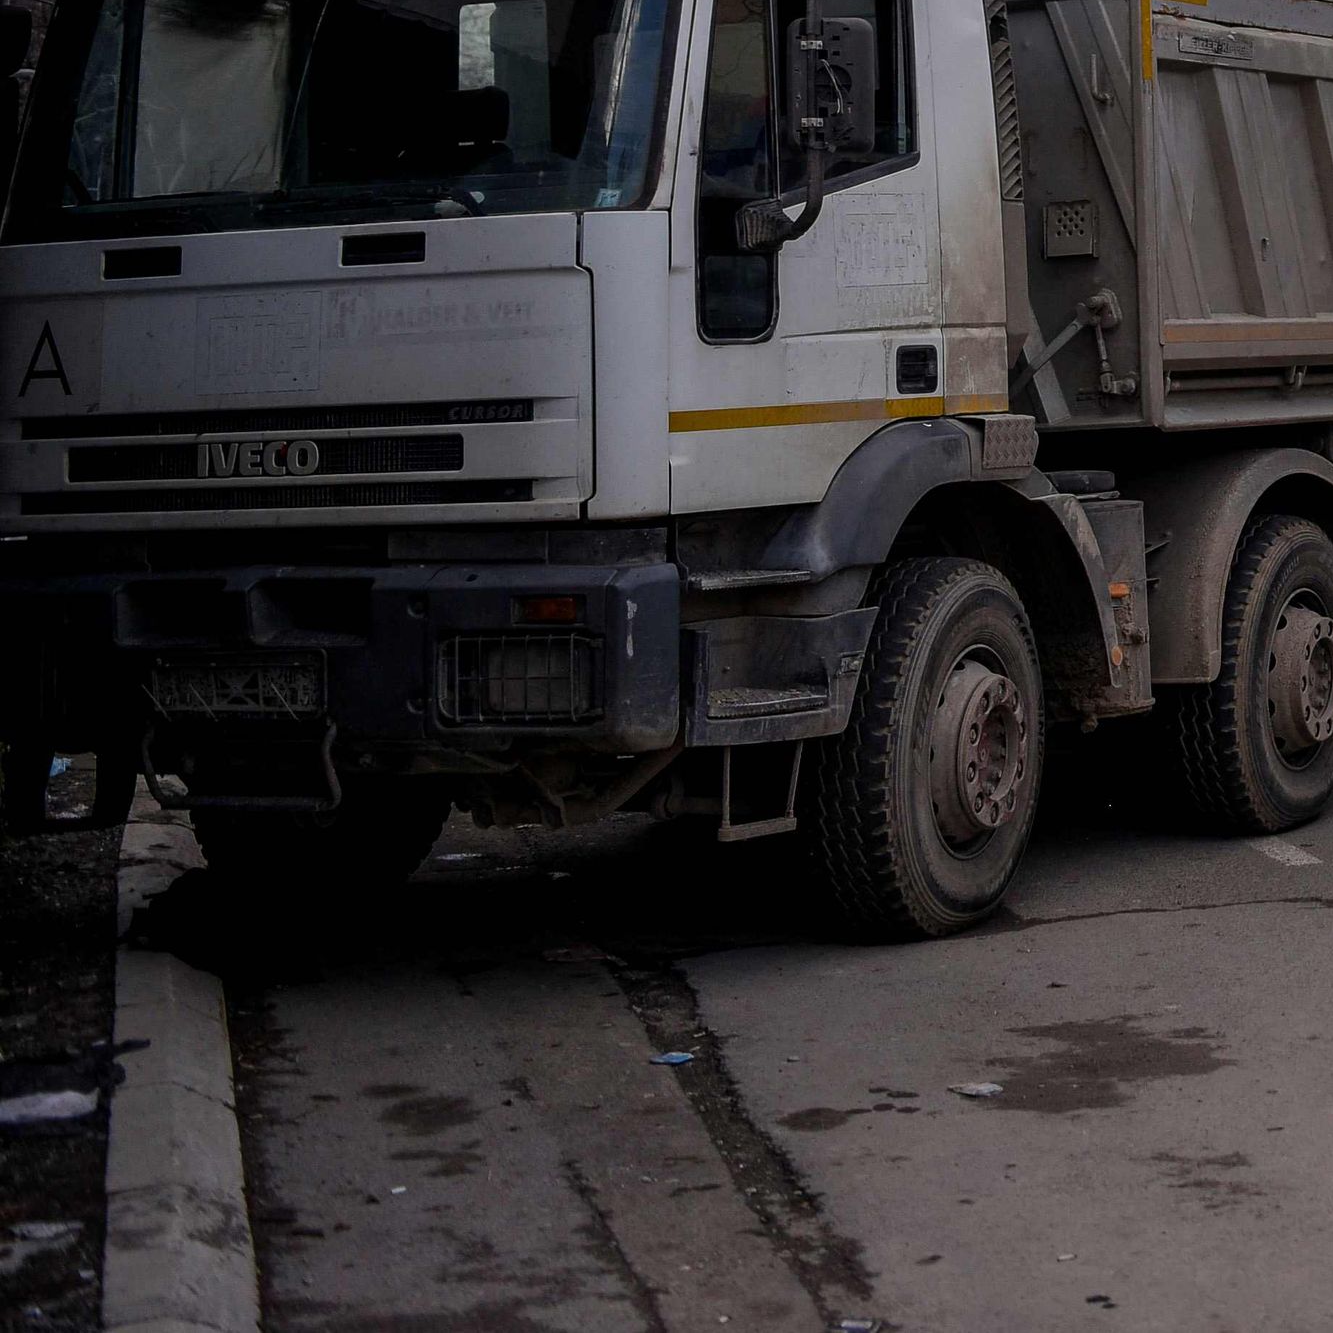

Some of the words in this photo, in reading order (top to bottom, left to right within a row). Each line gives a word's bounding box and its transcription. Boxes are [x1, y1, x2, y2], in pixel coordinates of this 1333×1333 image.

[18, 319, 73, 397] A
[448, 404, 525, 420] CURSOR
[198, 440, 319, 477] IVECO
